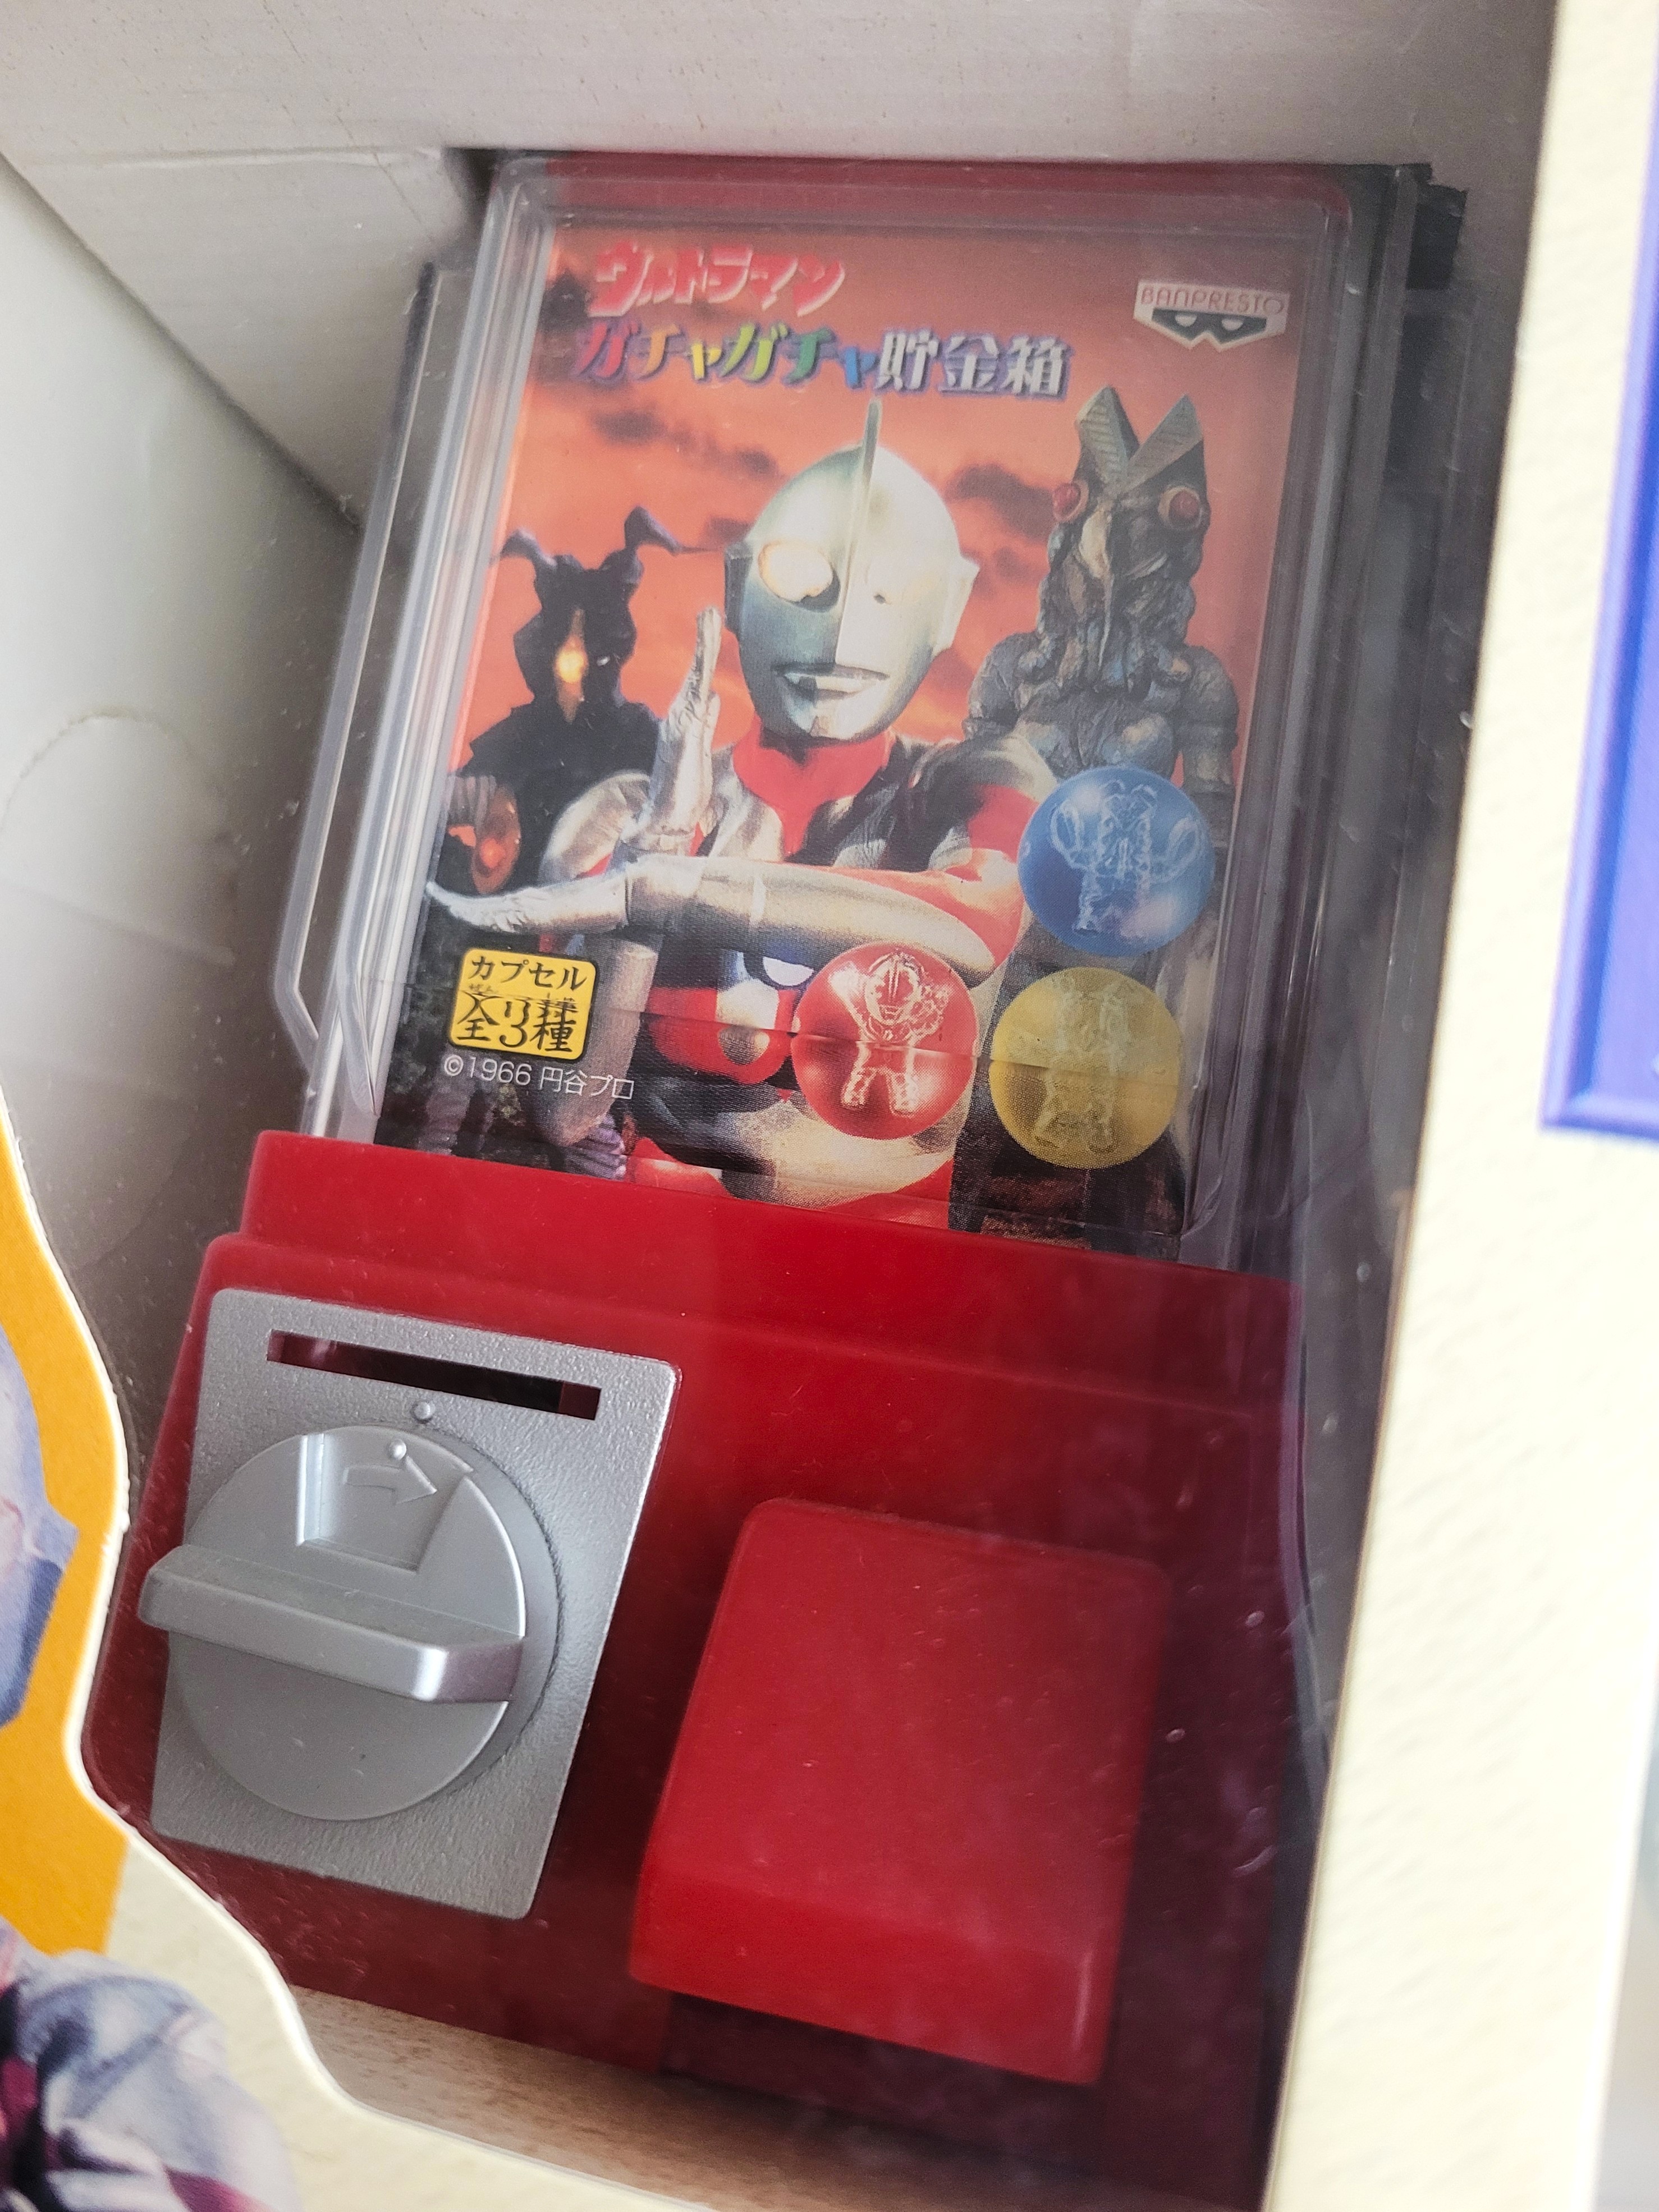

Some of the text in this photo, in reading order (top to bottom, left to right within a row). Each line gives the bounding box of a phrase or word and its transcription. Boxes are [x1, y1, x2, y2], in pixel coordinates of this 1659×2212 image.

[587, 241, 845, 318] ウルトラマン
[1140, 285, 1284, 314] BANPRESTO
[575, 324, 1066, 397] ガチャガチャ貯金箱
[469, 956, 586, 991] カプセル
[457, 992, 579, 1052] 全3種
[539, 1066, 635, 1099] 円谷プロ
